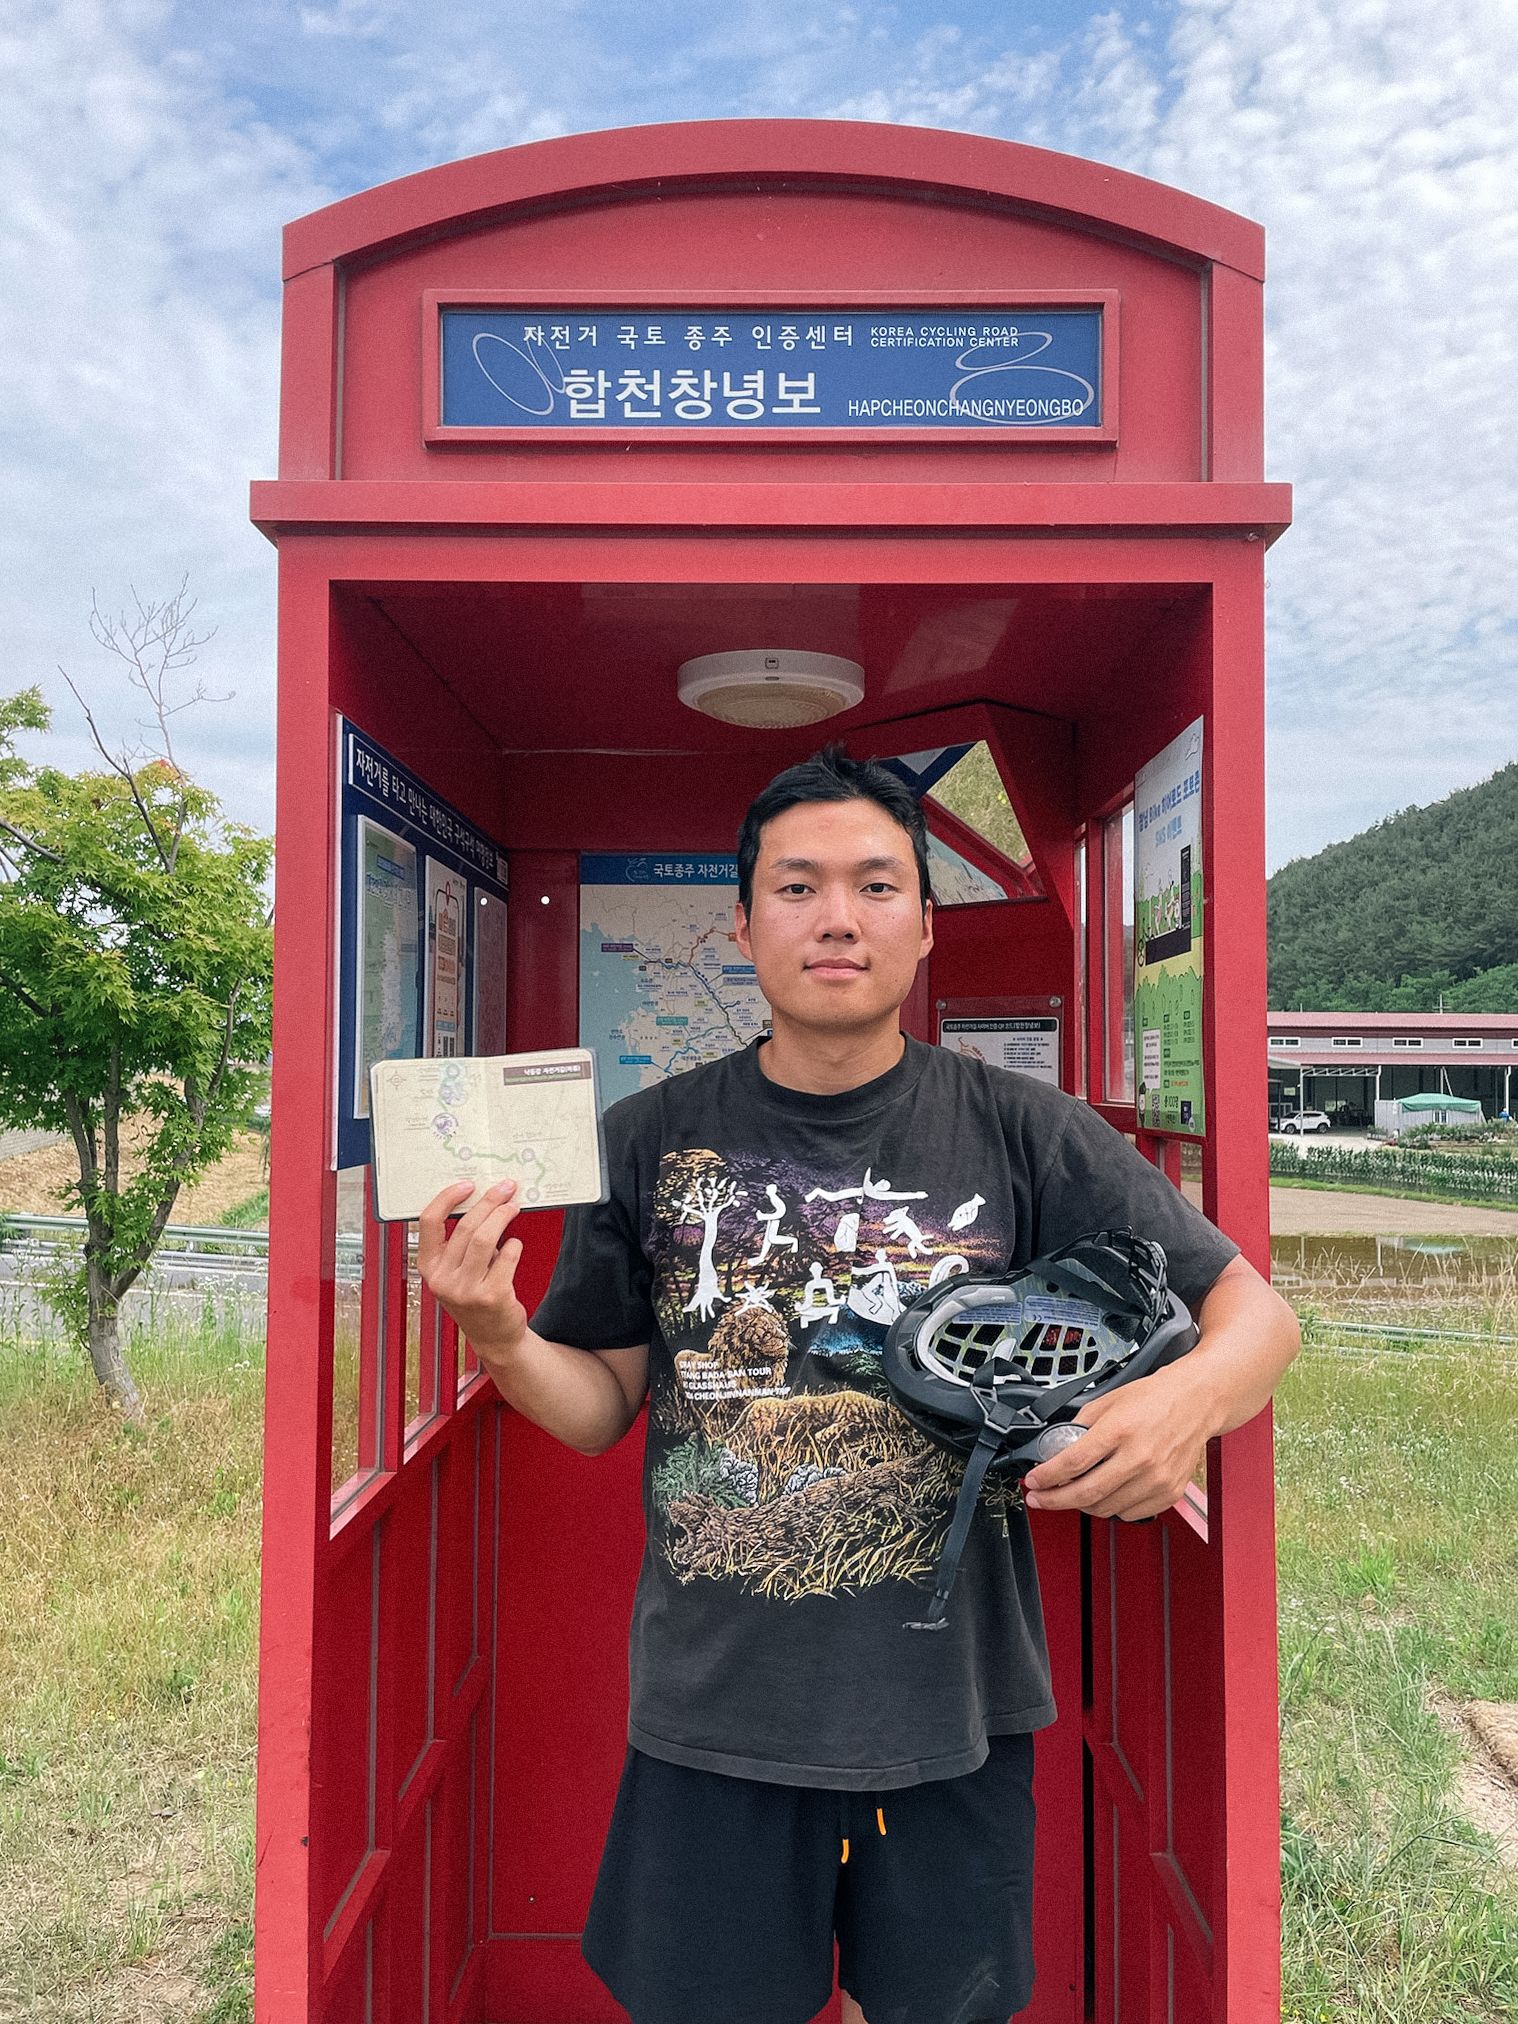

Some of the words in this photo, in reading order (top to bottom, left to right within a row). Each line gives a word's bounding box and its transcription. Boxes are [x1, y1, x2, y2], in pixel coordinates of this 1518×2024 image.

[522, 325, 599, 348] 자전거
[616, 325, 667, 348] 국토
[683, 324, 734, 351] 종주
[750, 323, 855, 351] 인증센터
[870, 326, 914, 337] KOREA
[919, 326, 977, 337] CYCLING
[982, 326, 1019, 337] ROAD
[870, 337, 964, 348] CERTIFICATION
[969, 337, 1020, 348] CENTER
[563, 368, 822, 420] 합천창녕보
[848, 398, 1085, 418] HAPCHEONCHANGNYEONGBO
[356, 748, 390, 798] 자전거를
[391, 775, 408, 804] 타고
[408, 788, 430, 825] 만나는
[653, 863, 695, 879] 국토종주
[697, 863, 739, 879] 자전거길
[747, 1367, 772, 1377] TOUR
